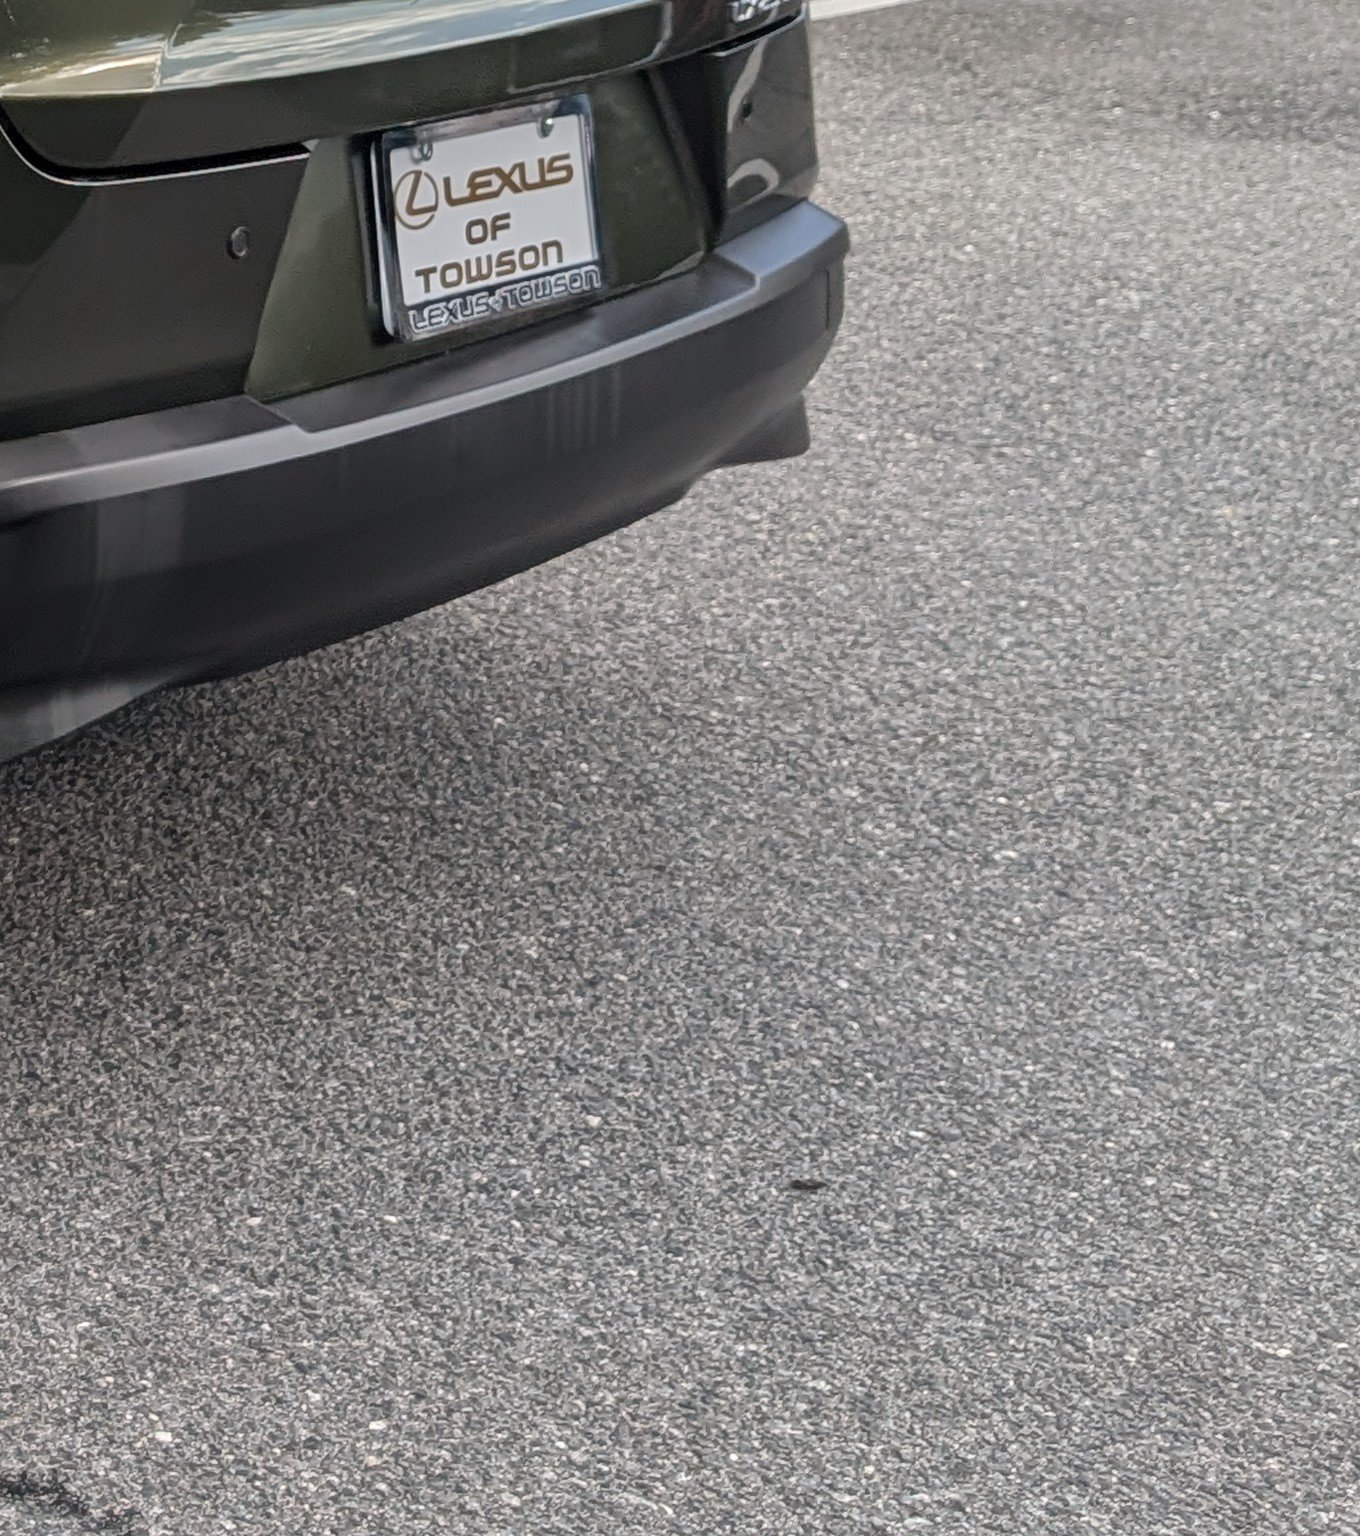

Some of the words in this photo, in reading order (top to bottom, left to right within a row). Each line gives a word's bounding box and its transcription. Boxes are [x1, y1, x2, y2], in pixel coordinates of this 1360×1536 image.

[443, 153, 574, 207] LEXUS
[466, 212, 511, 245] OF
[415, 239, 563, 293] TOWSON
[409, 293, 492, 332] LEXUS
[500, 266, 600, 310] TOWSON
